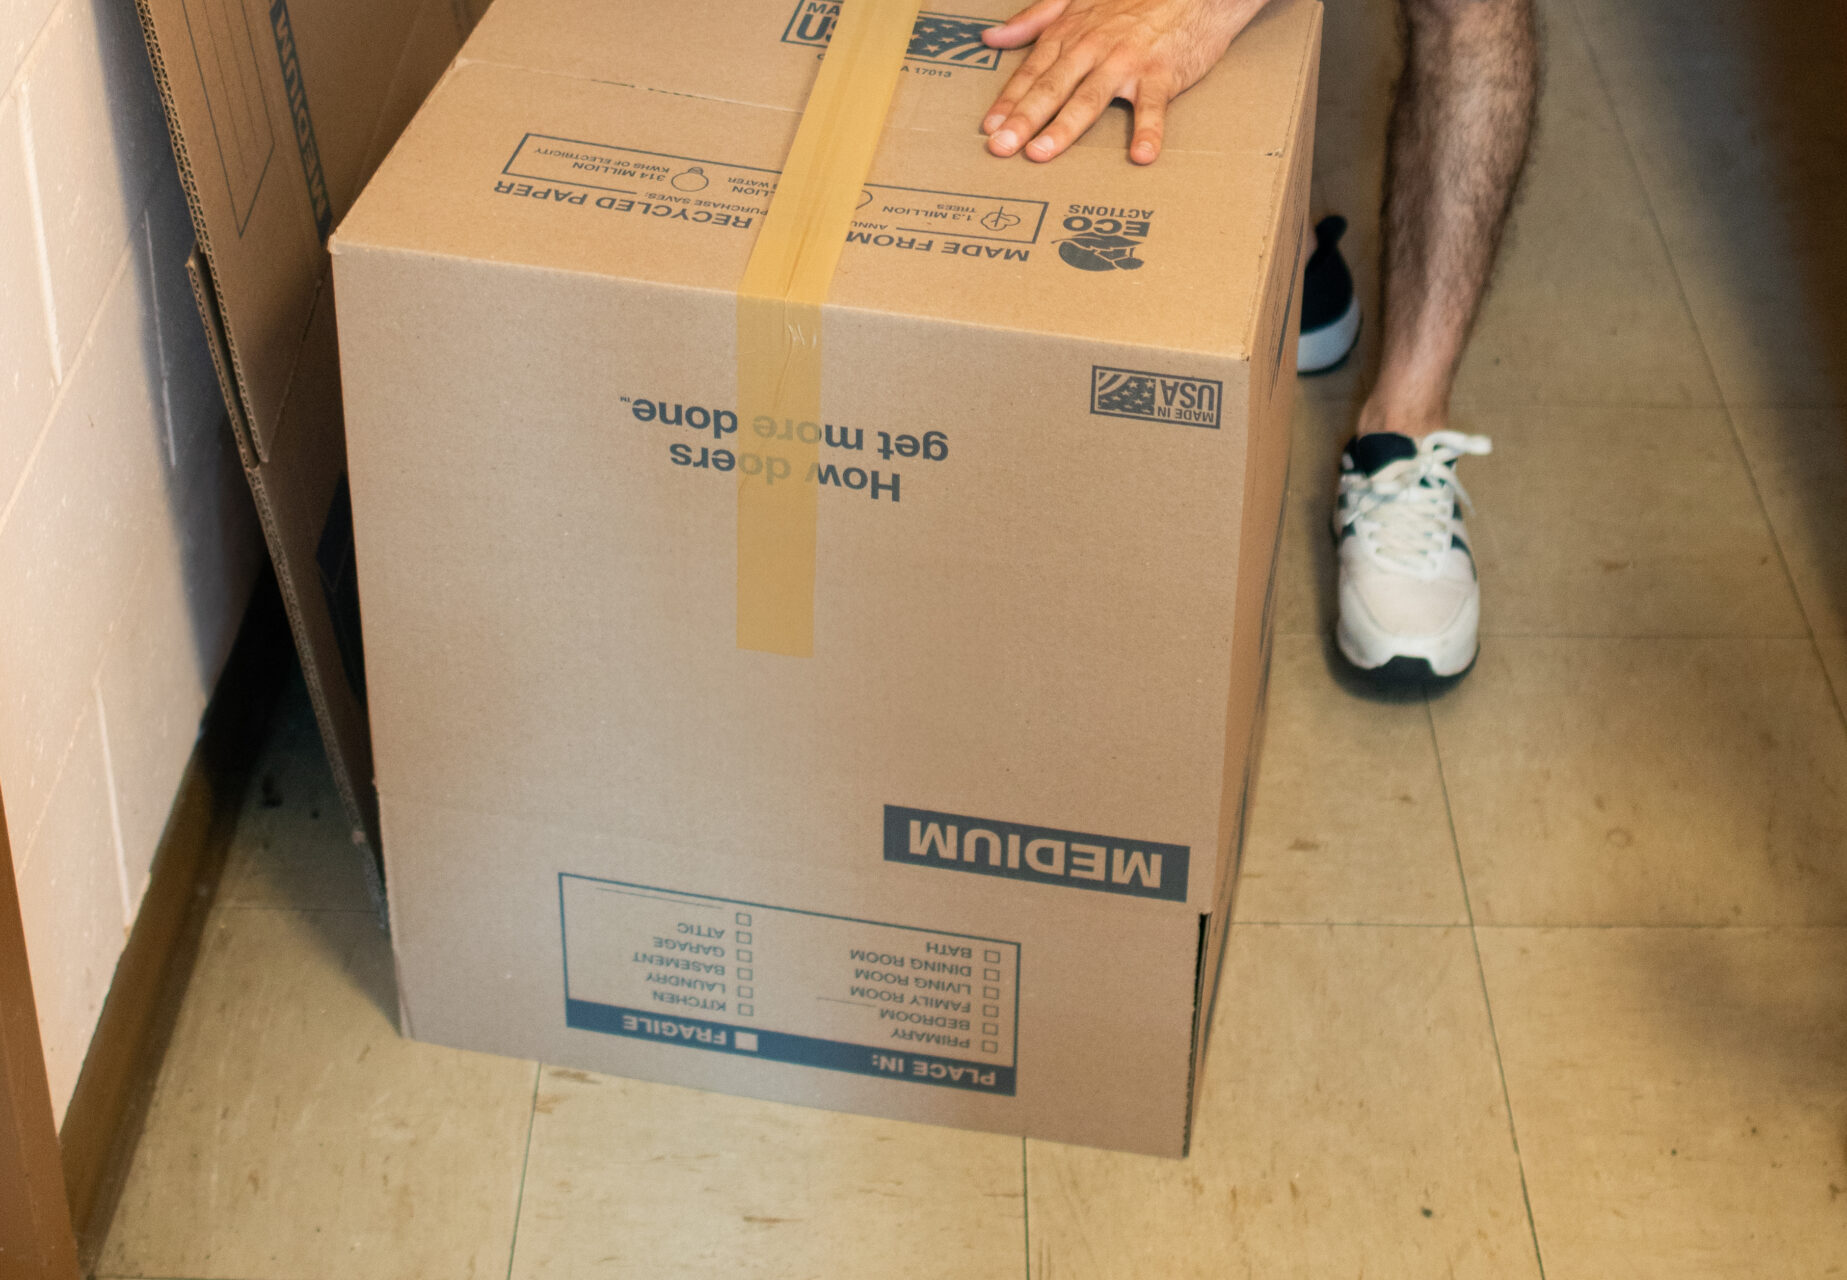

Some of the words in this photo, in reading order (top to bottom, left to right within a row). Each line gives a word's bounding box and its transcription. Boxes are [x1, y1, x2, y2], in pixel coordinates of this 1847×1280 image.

[534, 147, 612, 166] ELECTRICITY
[616, 160, 631, 169] OF
[572, 160, 637, 179] MILLION
[639, 171, 666, 183] 314
[727, 176, 770, 188] WATER
[493, 180, 589, 206] PAPER
[595, 194, 753, 230] RECYCLED
[694, 198, 769, 217] PURCHASE
[882, 204, 949, 221] MILLION
[936, 203, 976, 214] TREES
[952, 212, 973, 222] 1.3
[1067, 203, 1156, 221] ACTIONS
[1062, 215, 1152, 239] ECO
[844, 229, 933, 252] FROM
[940, 239, 1031, 262] MADE
[1159, 378, 1215, 412] USA
[1157, 405, 1172, 418] IN
[1175, 408, 1215, 424] MADE
[752, 413, 865, 452] more
[876, 430, 950, 462] get
[668, 442, 793, 486] doers
[803, 461, 901, 503] How
[908, 819, 1163, 889] MEDIUM
[677, 922, 726, 940] ATTIC
[652, 936, 726, 959] GARAGE
[849, 948, 905, 968] ROOM
[925, 941, 973, 960] BATH
[632, 951, 726, 977] BASEMENT
[910, 957, 972, 978] DINING
[645, 971, 726, 995] LAUNDRY
[854, 968, 910, 987] ROOM
[913, 976, 972, 996] LIVING
[651, 989, 727, 1013] KITCHEN
[849, 985, 905, 1004] ROOM
[909, 994, 972, 1014] FAMILY
[879, 1007, 971, 1031] BEDROOM
[622, 1014, 728, 1046] FRAGILE
[890, 1027, 971, 1050] PRIMARY
[871, 1053, 905, 1074] IN:
[912, 1060, 997, 1087] PLACE
